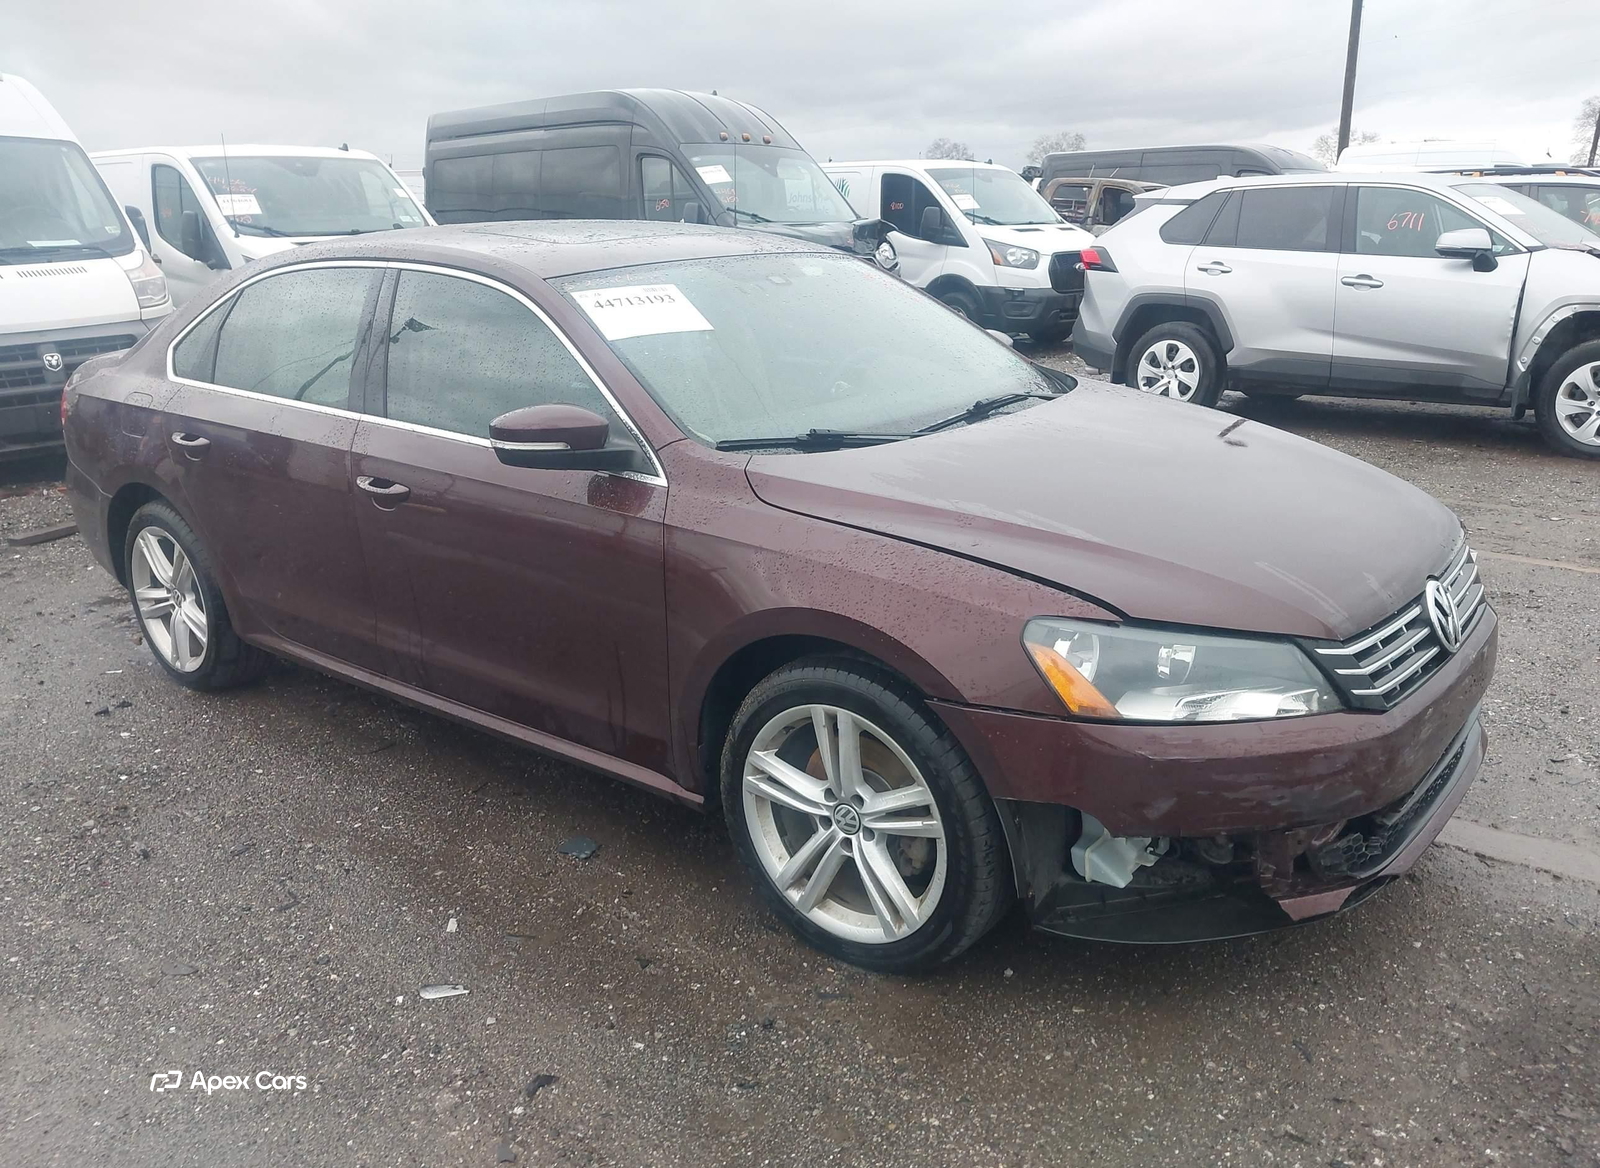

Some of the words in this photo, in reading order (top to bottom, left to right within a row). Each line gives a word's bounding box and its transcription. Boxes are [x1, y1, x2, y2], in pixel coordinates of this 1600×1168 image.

[788, 191, 823, 204] Johnsn
[1387, 211, 1425, 231] 6711
[593, 294, 676, 309] 44713193
